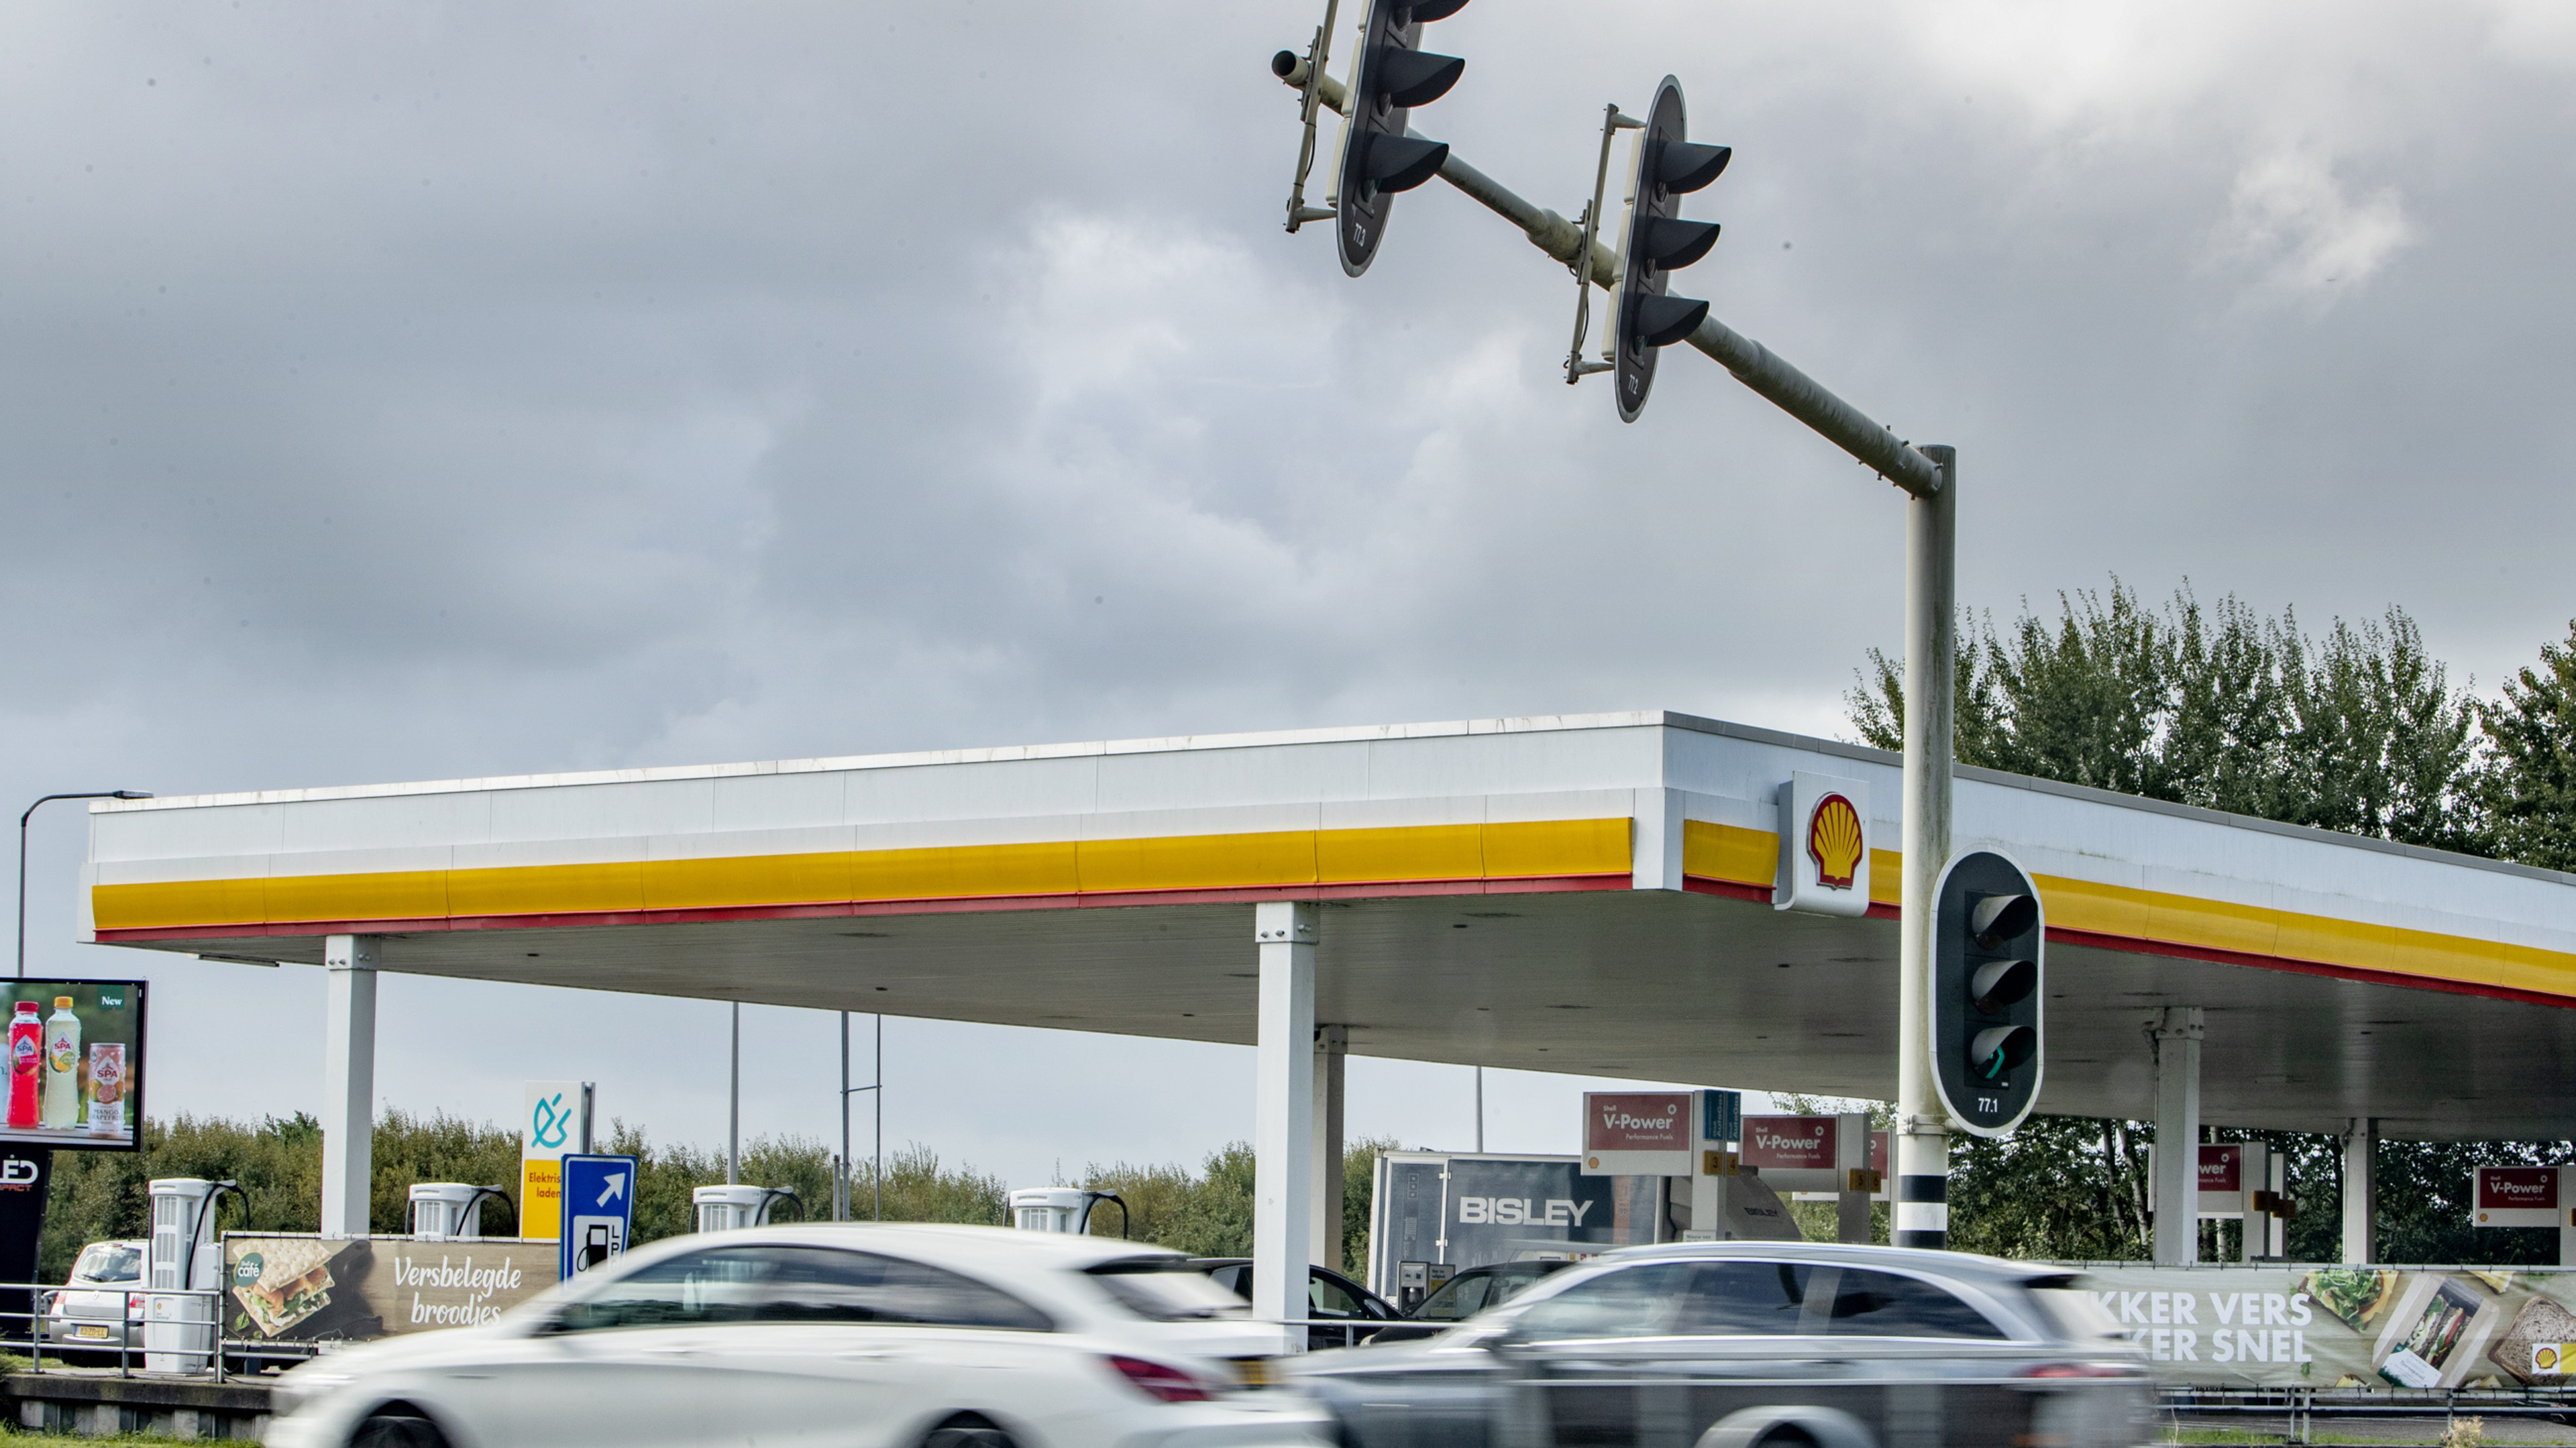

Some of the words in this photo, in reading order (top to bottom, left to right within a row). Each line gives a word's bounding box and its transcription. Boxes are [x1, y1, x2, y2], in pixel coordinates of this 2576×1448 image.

[101, 996, 123, 1005] New
[97, 1070, 118, 1078] SPA
[1978, 1097, 1998, 1113] 77.1
[1603, 1113, 1674, 1129] V-Power
[1756, 1135, 1821, 1150] V-Power
[1713, 1156, 1718, 1169] 3
[529, 1172, 561, 1183] Elektris
[537, 1187, 561, 1198] laden
[2490, 1182, 2544, 1194] V-Power
[1459, 1196, 1594, 1227] BISLEY
[237, 1262, 260, 1277] café
[394, 1255, 521, 1298] Versbelegde
[411, 1291, 501, 1328] broodjes
[2090, 1291, 2199, 1325] KKER
[2209, 1292, 2312, 1326] VERS
[2132, 1329, 2199, 1362] KER
[2212, 1329, 2312, 1363] SNEL
